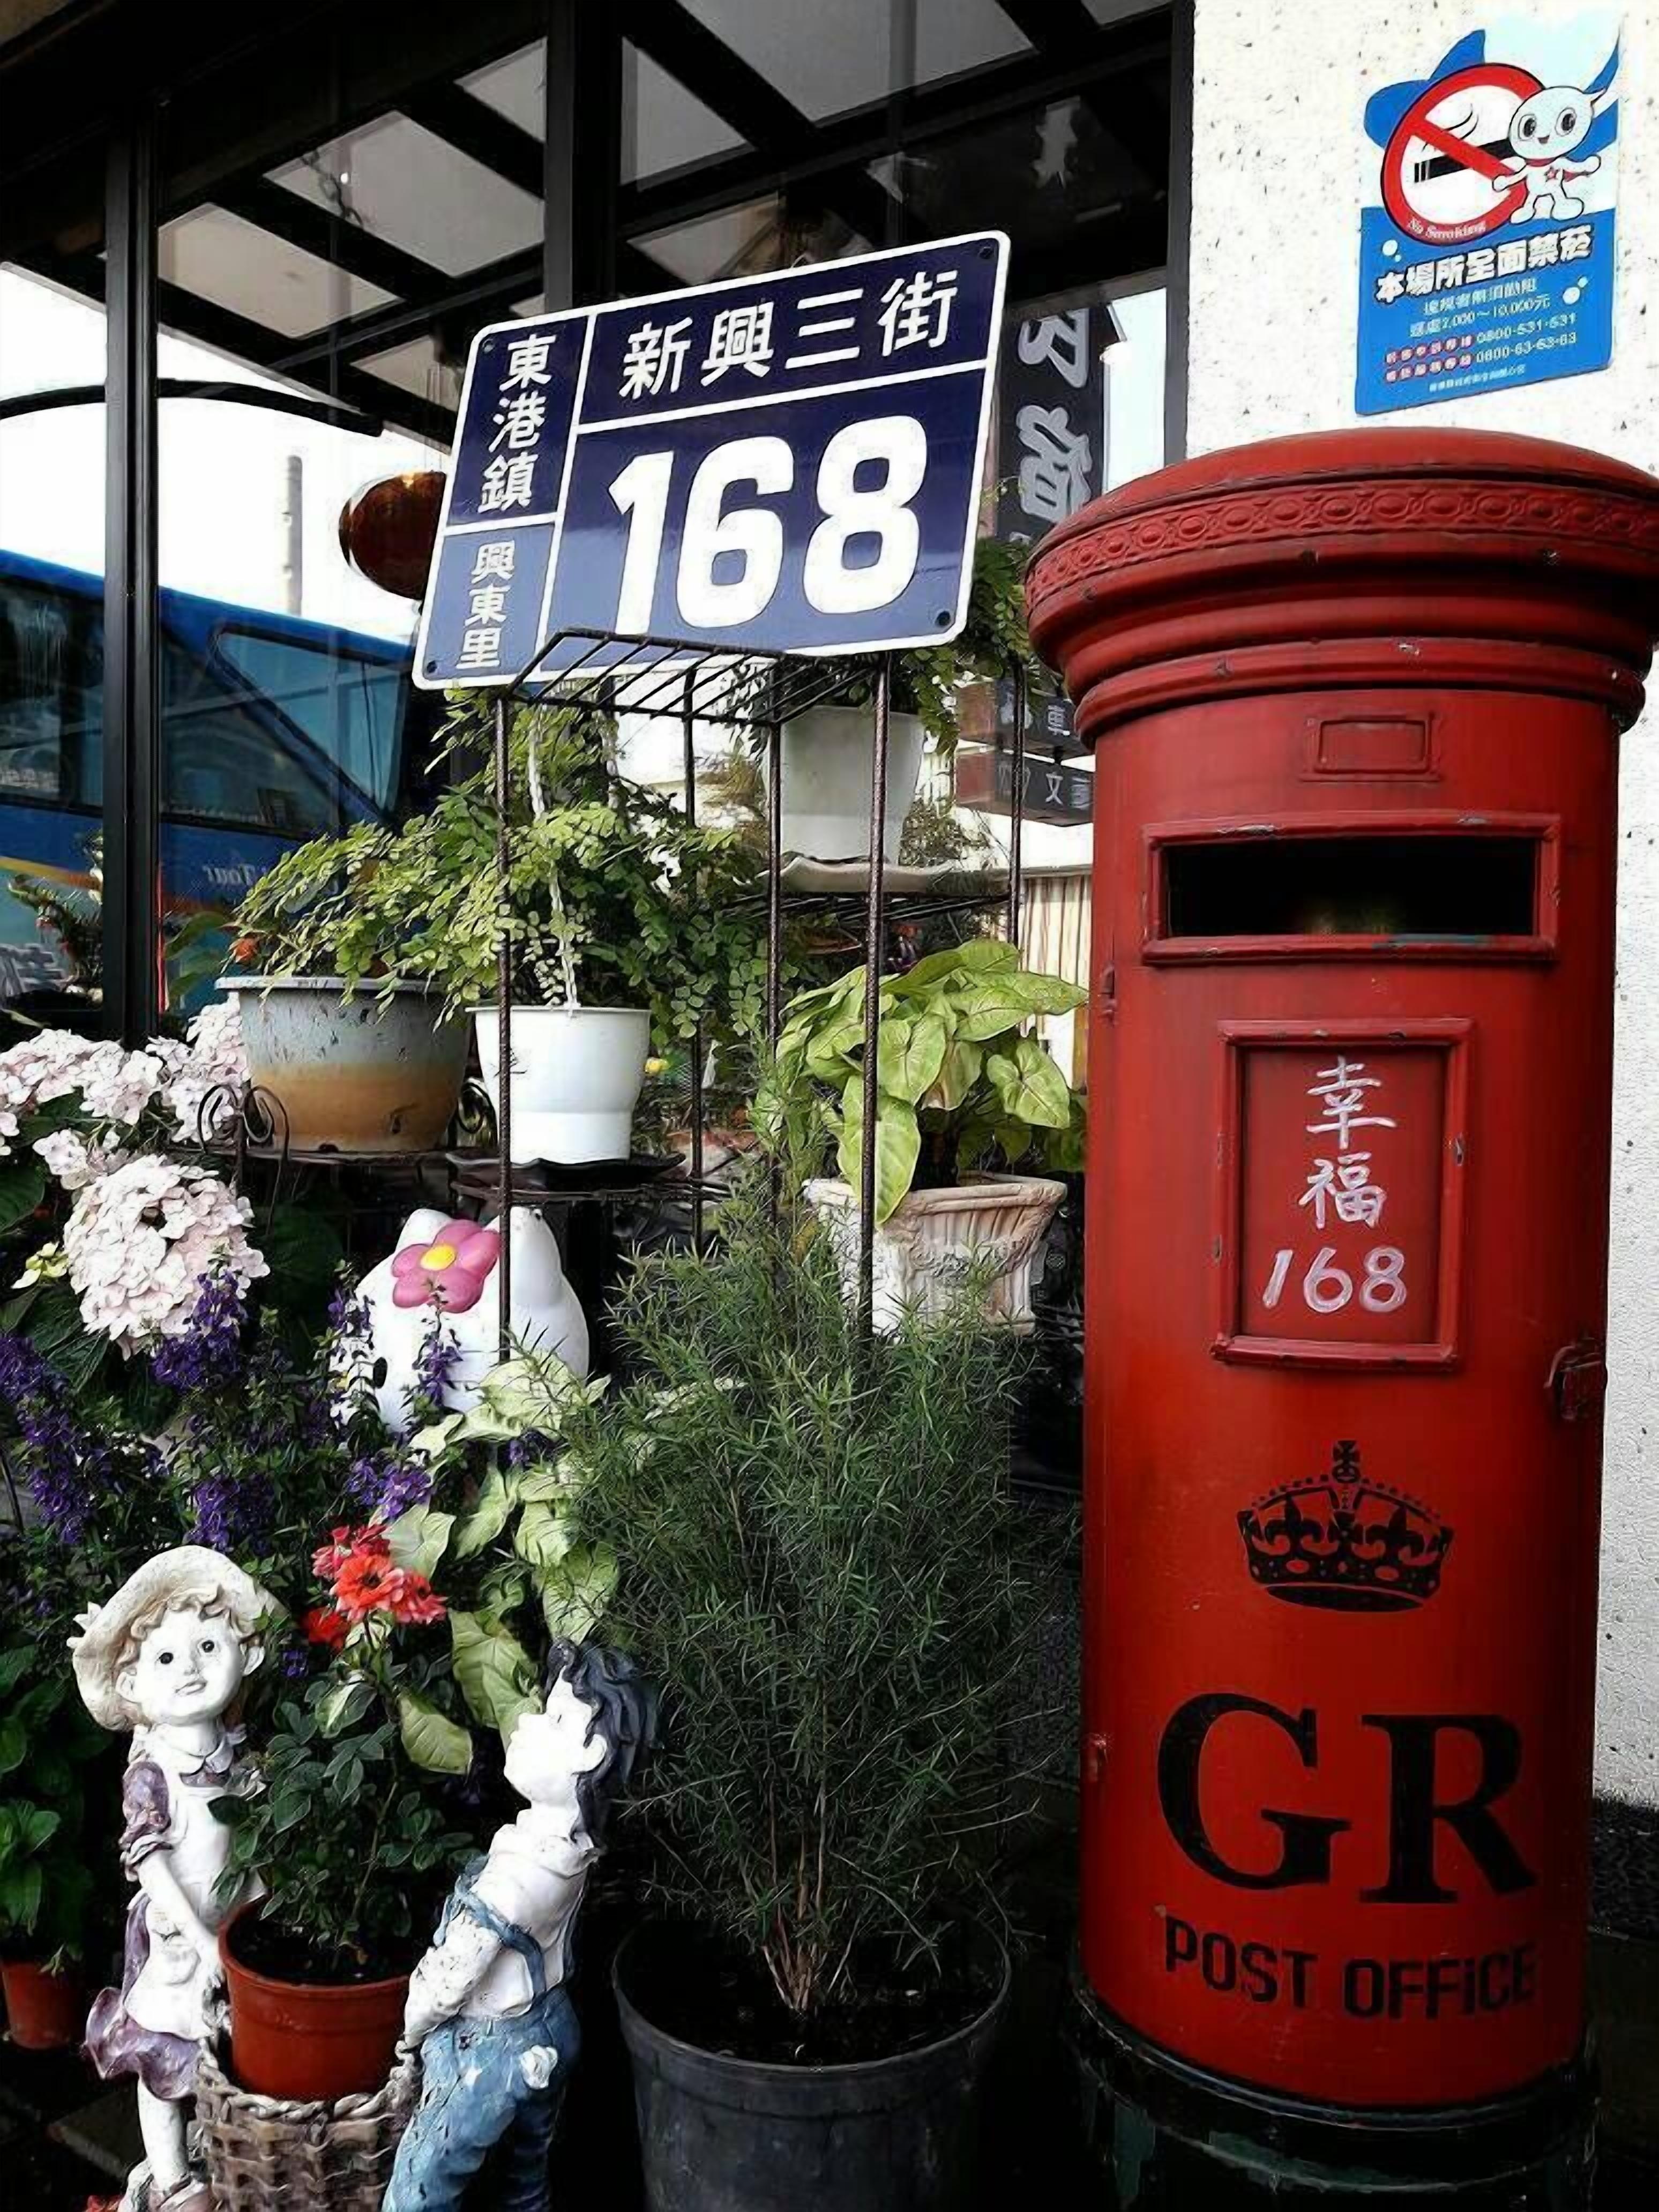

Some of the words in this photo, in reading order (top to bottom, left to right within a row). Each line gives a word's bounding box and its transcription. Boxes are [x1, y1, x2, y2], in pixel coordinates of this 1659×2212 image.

[619, 270, 959, 400] 新興三街
[477, 333, 557, 515] 東港鎮
[609, 414, 928, 635] 168
[455, 540, 516, 671] 興東里
[1298, 1055, 1397, 1229] 幸福
[1261, 1246, 1408, 1314] 168
[1157, 1692, 1538, 1904] GR
[1164, 1914, 1318, 2008] POST
